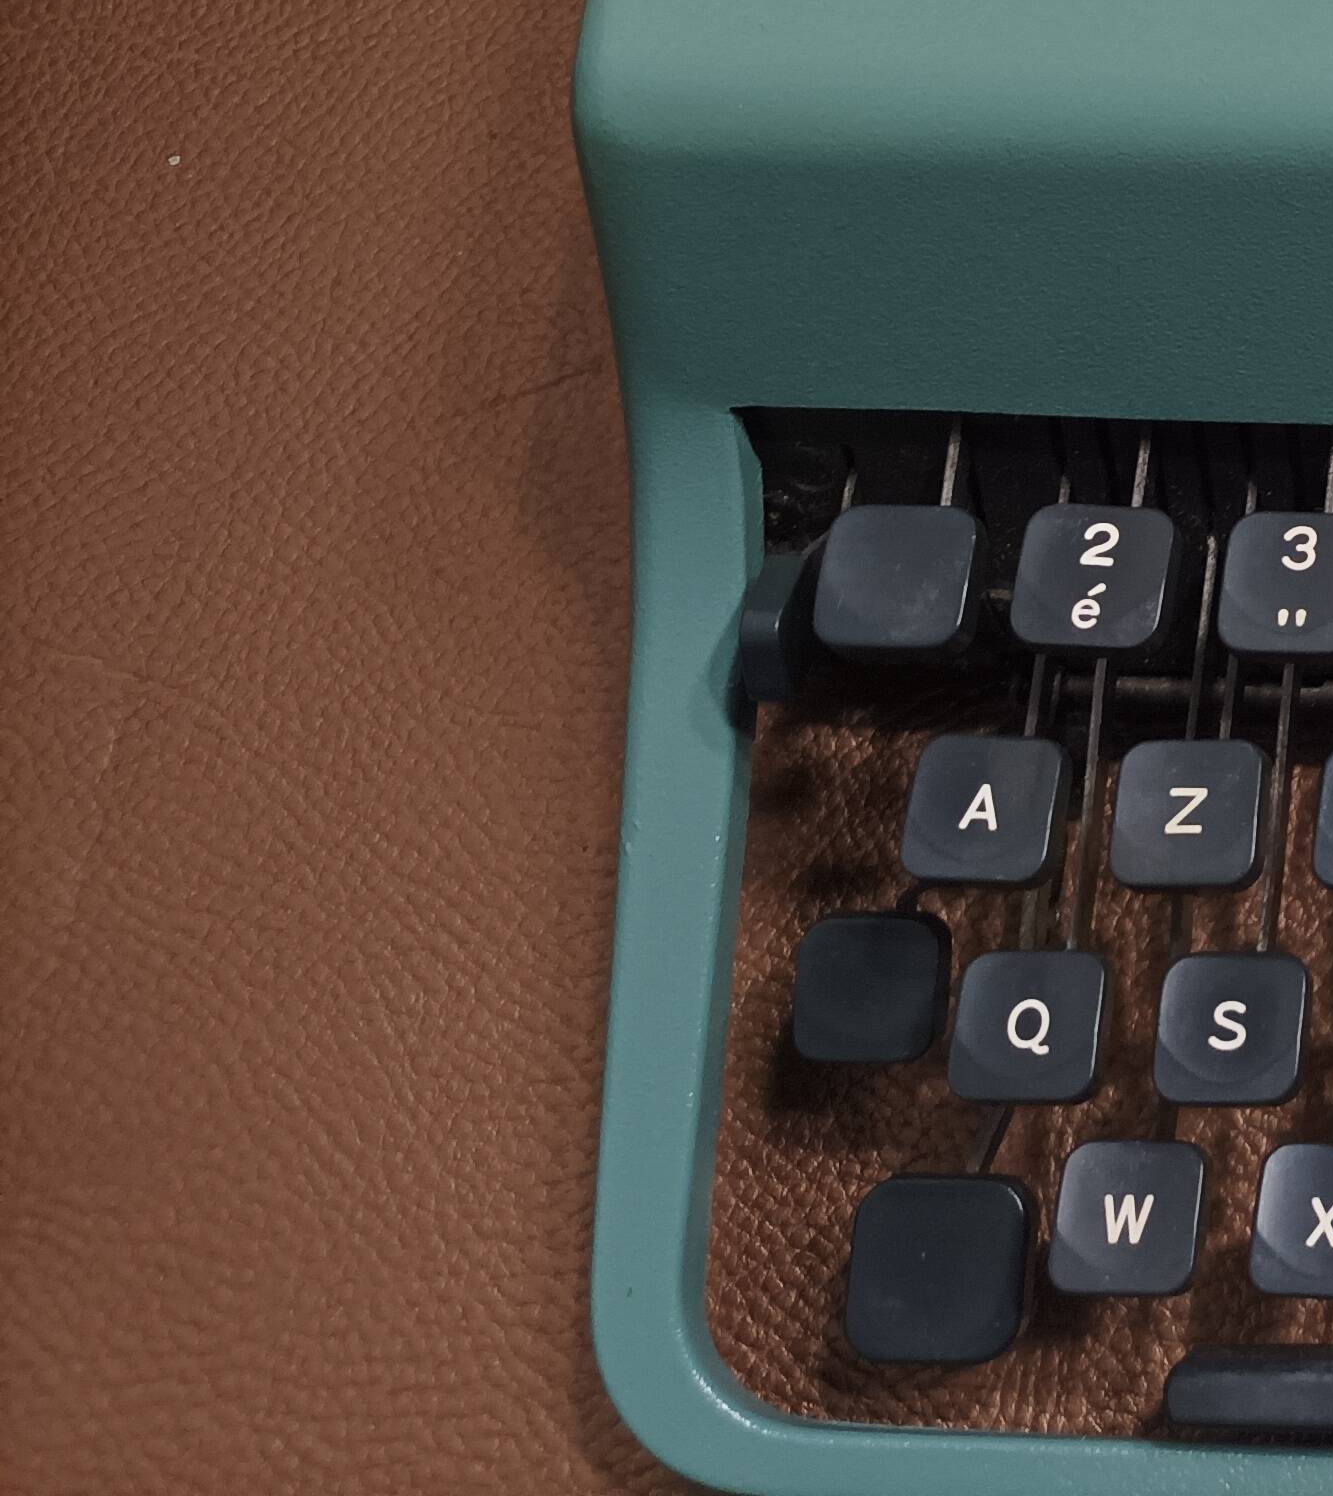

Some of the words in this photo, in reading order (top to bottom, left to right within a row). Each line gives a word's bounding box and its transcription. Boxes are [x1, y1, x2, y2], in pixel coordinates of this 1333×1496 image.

[1080, 522, 1120, 567] 2
[1281, 526, 1317, 570] 3
[1071, 584, 1107, 629] é
[959, 783, 998, 831] A
[1164, 787, 1208, 834] Z
[1006, 998, 1051, 1055] Q
[1208, 1001, 1247, 1051] S
[1104, 1193, 1154, 1245] W
